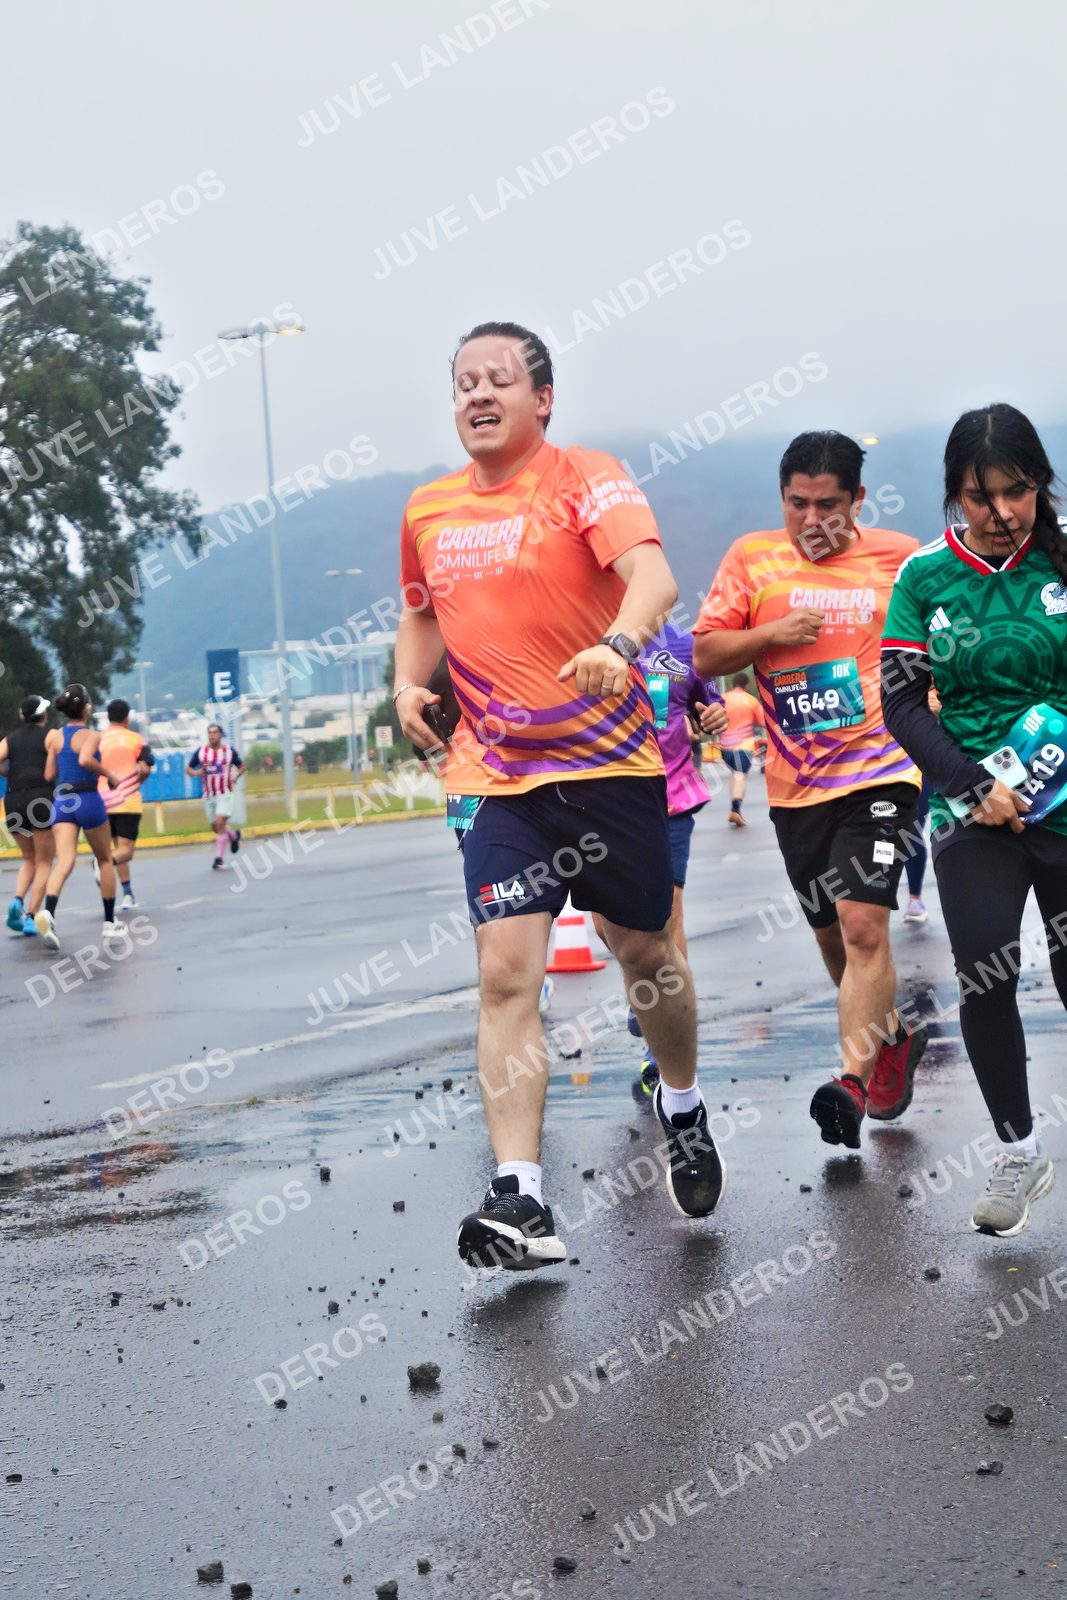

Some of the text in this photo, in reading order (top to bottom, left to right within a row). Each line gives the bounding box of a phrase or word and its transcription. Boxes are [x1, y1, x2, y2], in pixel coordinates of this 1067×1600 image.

[437, 514, 524, 551] CARRERA
[434, 546, 502, 570] OMNILIFE
[789, 587, 876, 612] CARRERA
[773, 672, 807, 687] CARRERA
[832, 663, 850, 679] 10K
[213, 671, 233, 698] E
[786, 689, 840, 715] 1649
[1022, 708, 1046, 737] 10K
[479, 880, 525, 903] FILA
